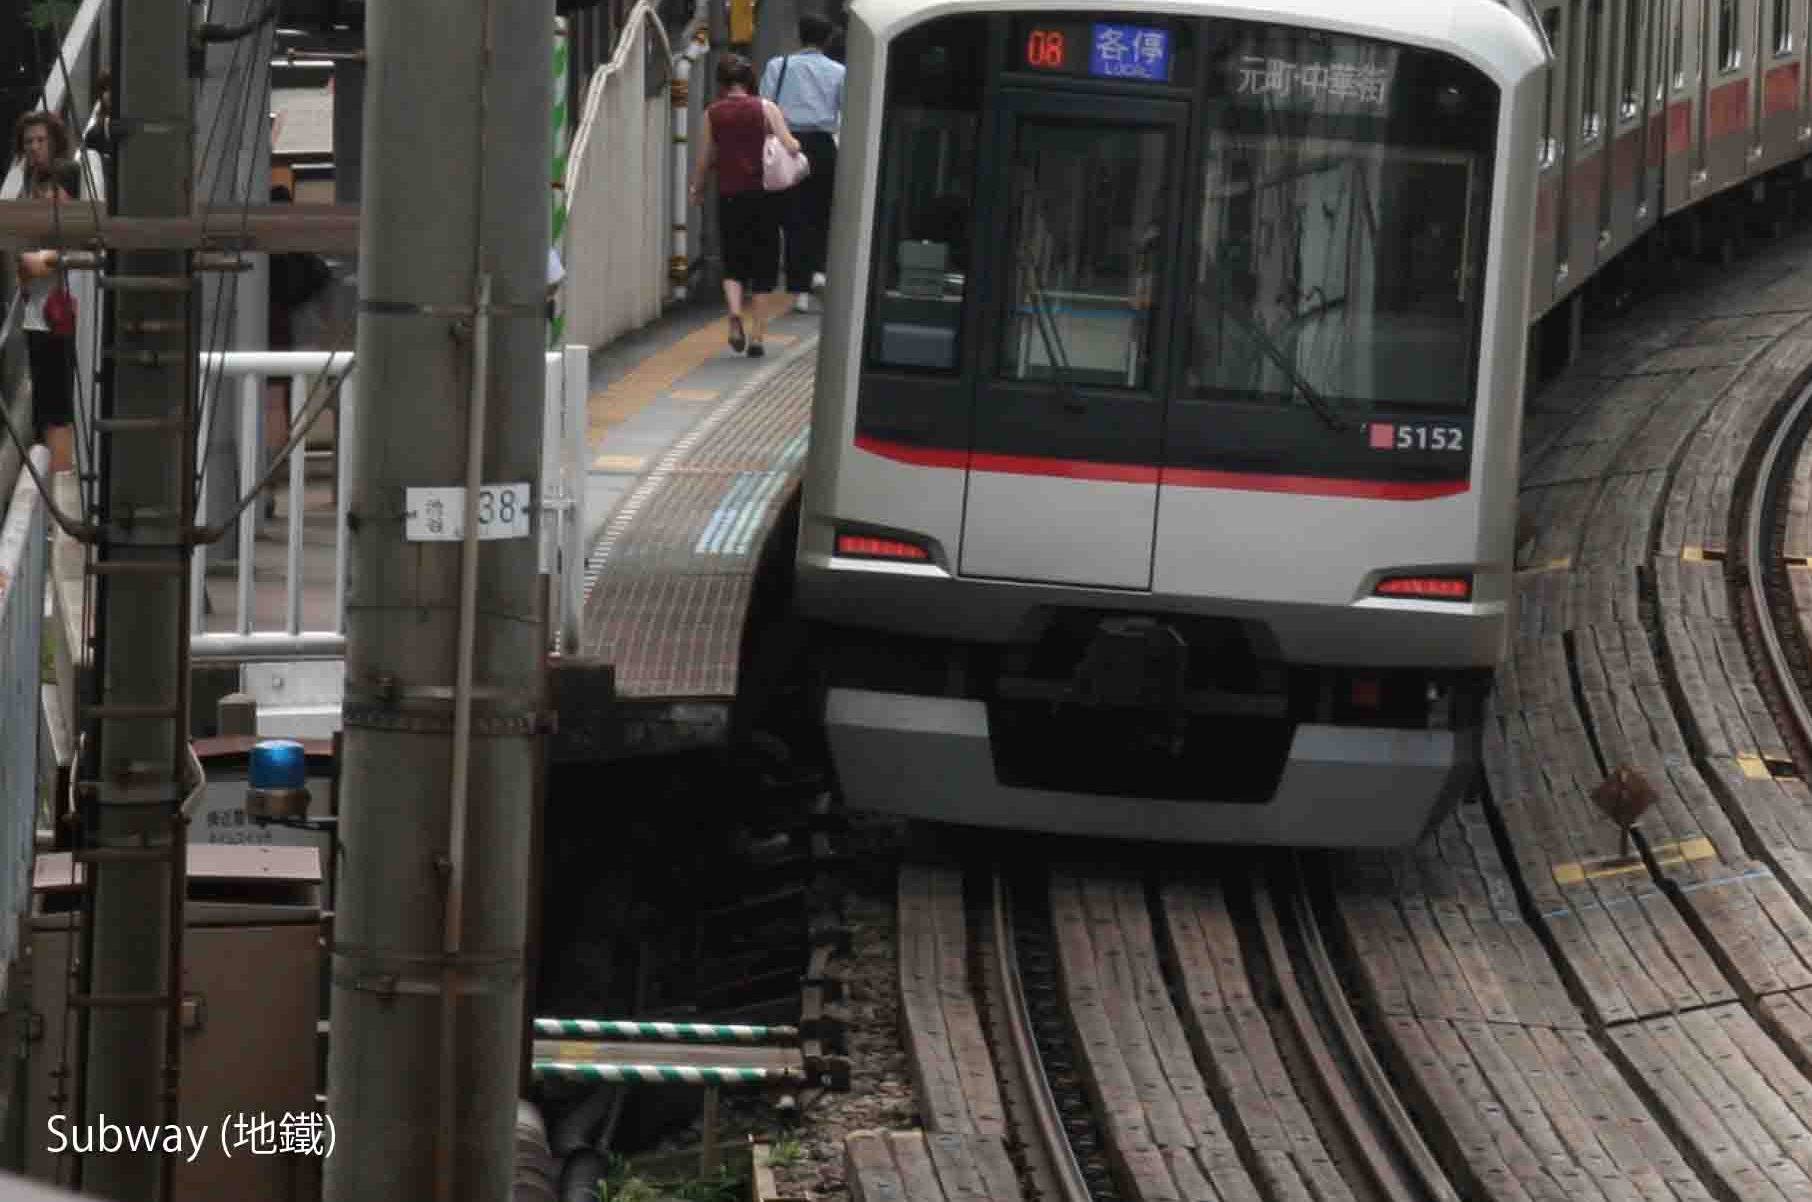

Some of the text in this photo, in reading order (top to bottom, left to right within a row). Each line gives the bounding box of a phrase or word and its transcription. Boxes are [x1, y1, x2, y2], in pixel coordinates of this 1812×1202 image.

[1028, 29, 1065, 67] 08
[1096, 28, 1166, 64] 各停
[1397, 425, 1464, 451] 5152
